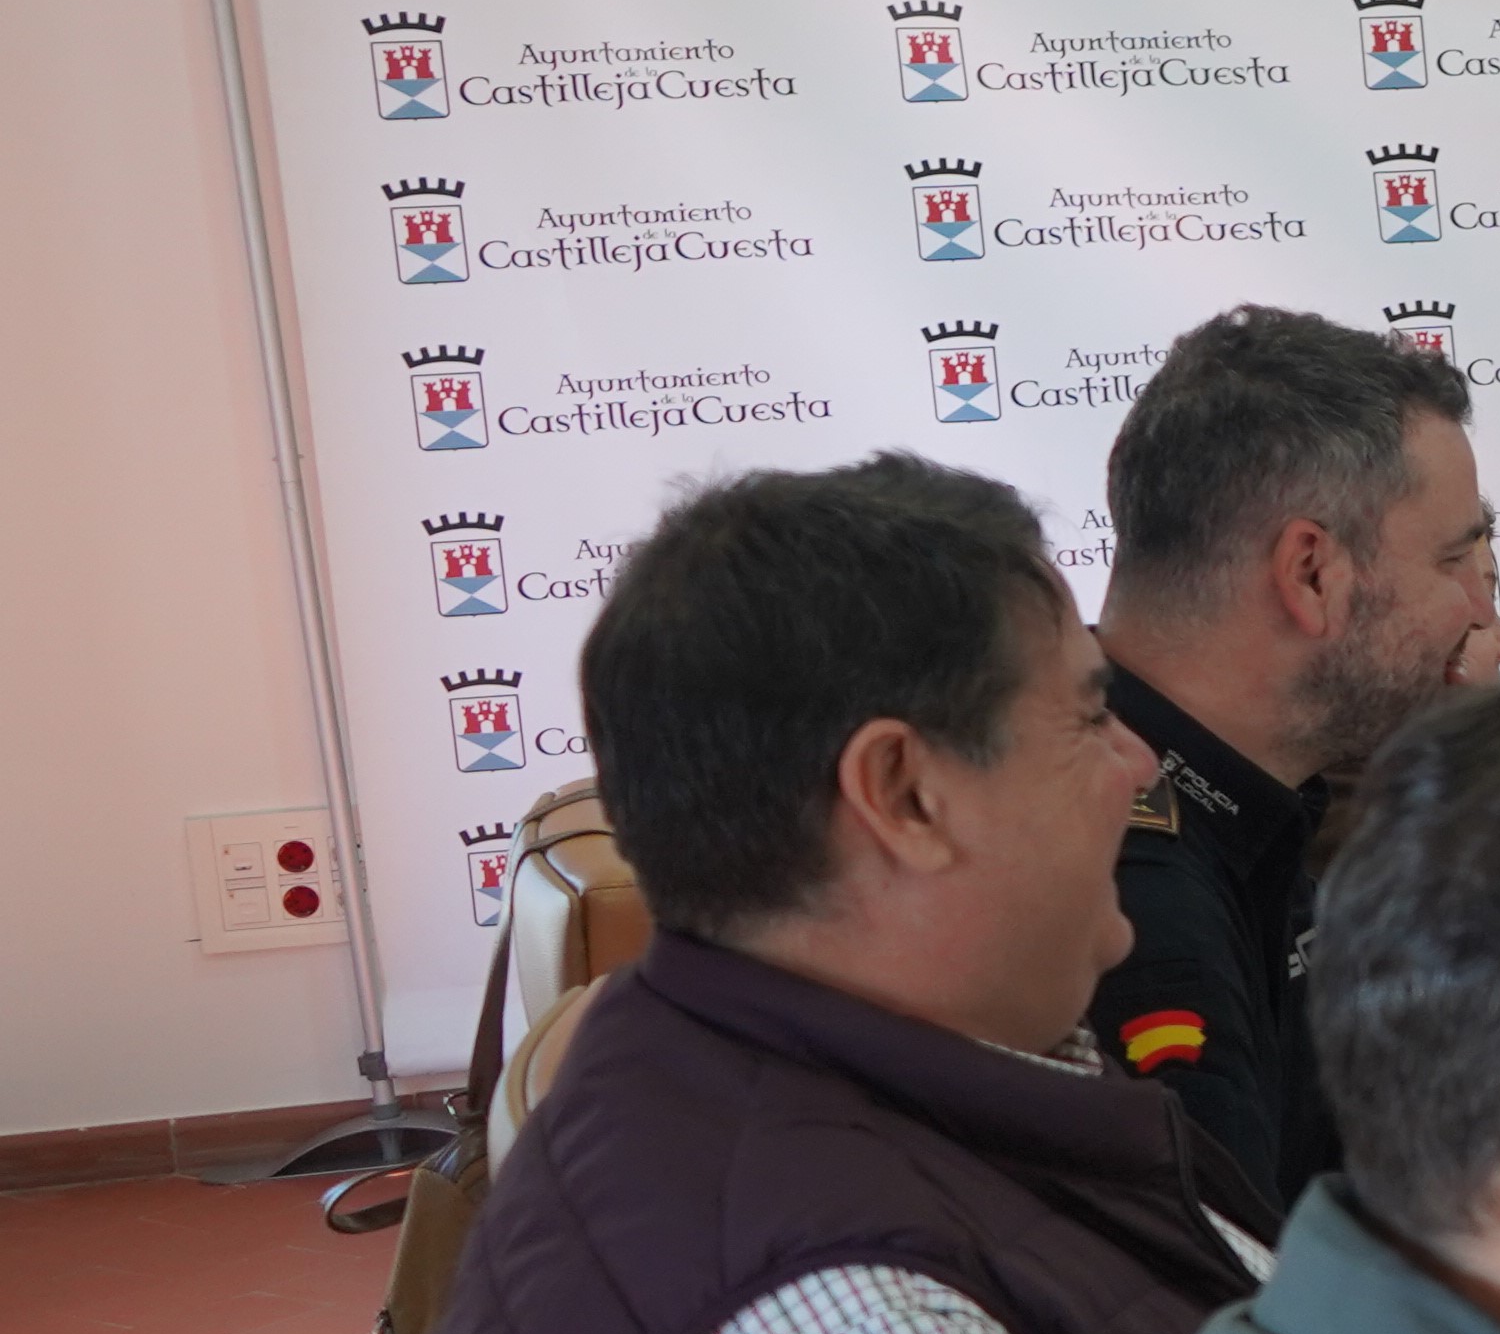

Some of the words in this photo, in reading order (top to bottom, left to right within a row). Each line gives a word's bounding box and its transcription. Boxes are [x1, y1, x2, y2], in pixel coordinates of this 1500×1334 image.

[518, 39, 734, 71] Ayuntamiento
[1030, 29, 1232, 60] Ayuntamiento
[1049, 184, 1249, 216] Ayuntamiento
[537, 201, 752, 235] Ayuntamiento
[556, 364, 770, 399] Ayuntamiento
[1173, 775, 1217, 814] LOCAL
